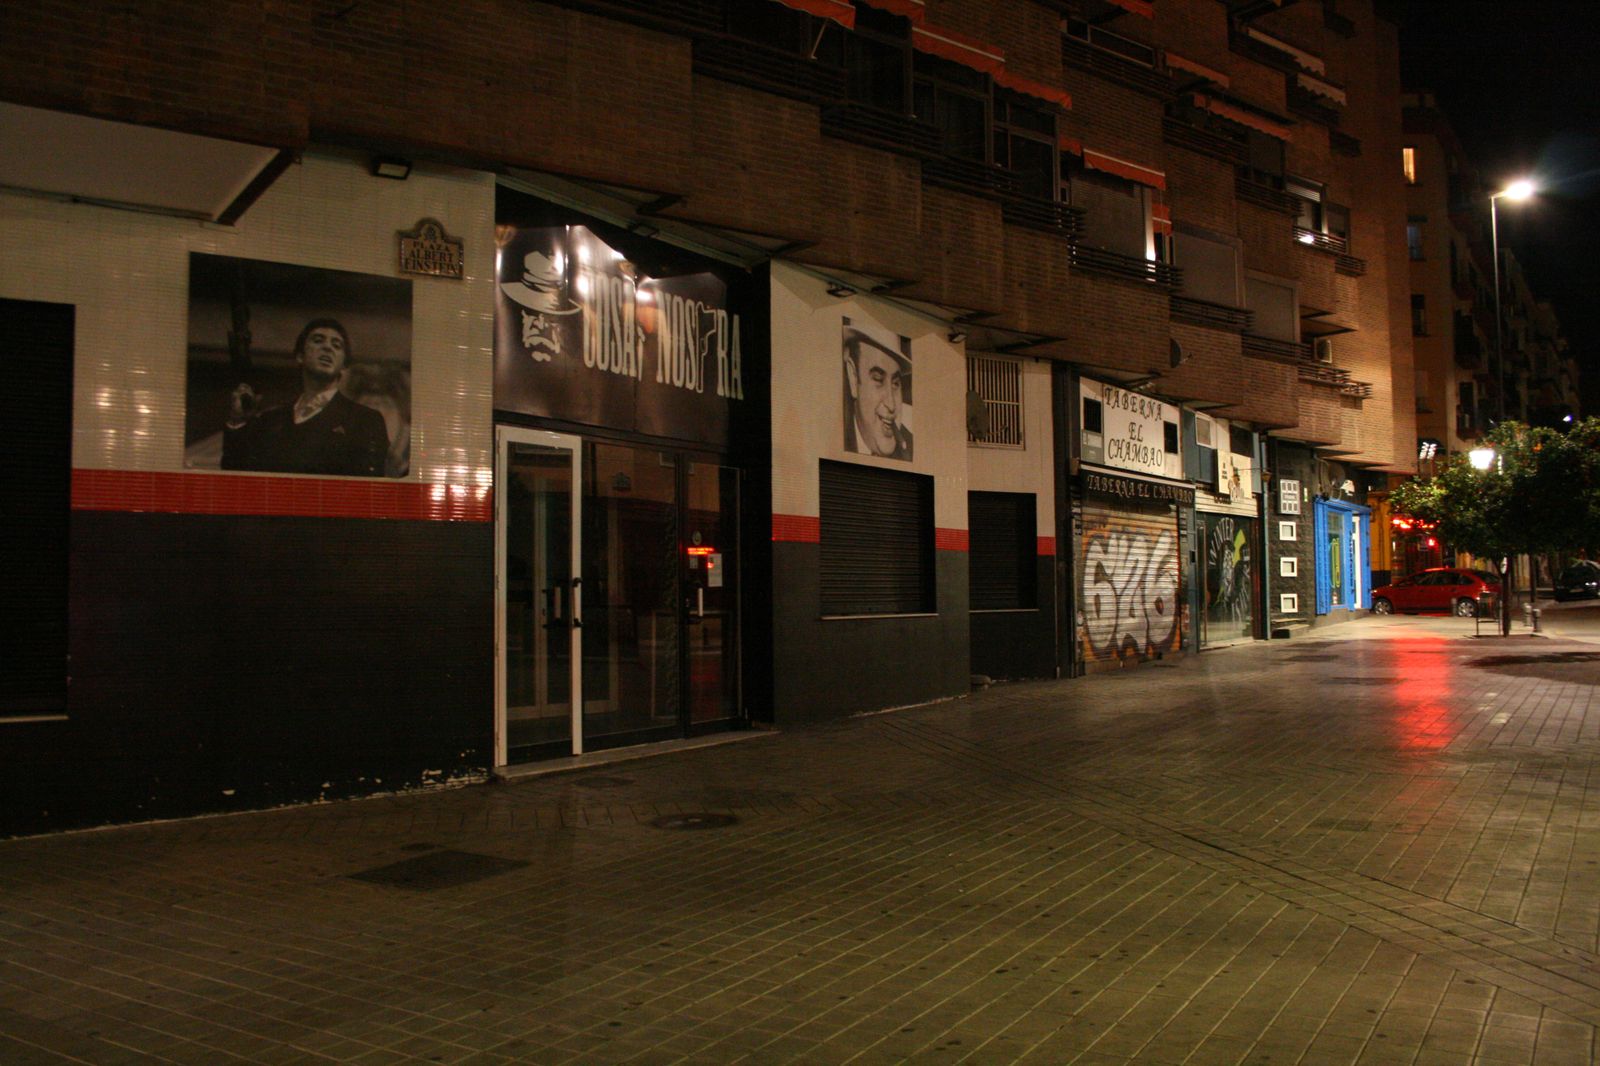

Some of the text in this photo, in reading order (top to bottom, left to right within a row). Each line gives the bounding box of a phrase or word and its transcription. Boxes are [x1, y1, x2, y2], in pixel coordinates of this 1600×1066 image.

[410, 249, 453, 264] ALBERT
[413, 241, 450, 253] PLAZA
[405, 258, 459, 276] EINSTEIN
[655, 288, 744, 401] NOSTRA
[1104, 386, 1162, 422] TABERNA
[1128, 421, 1143, 442] EL
[1107, 438, 1163, 468] CHAMBAO
[1087, 474, 1137, 499] TABERNA
[1138, 481, 1150, 498] EL
